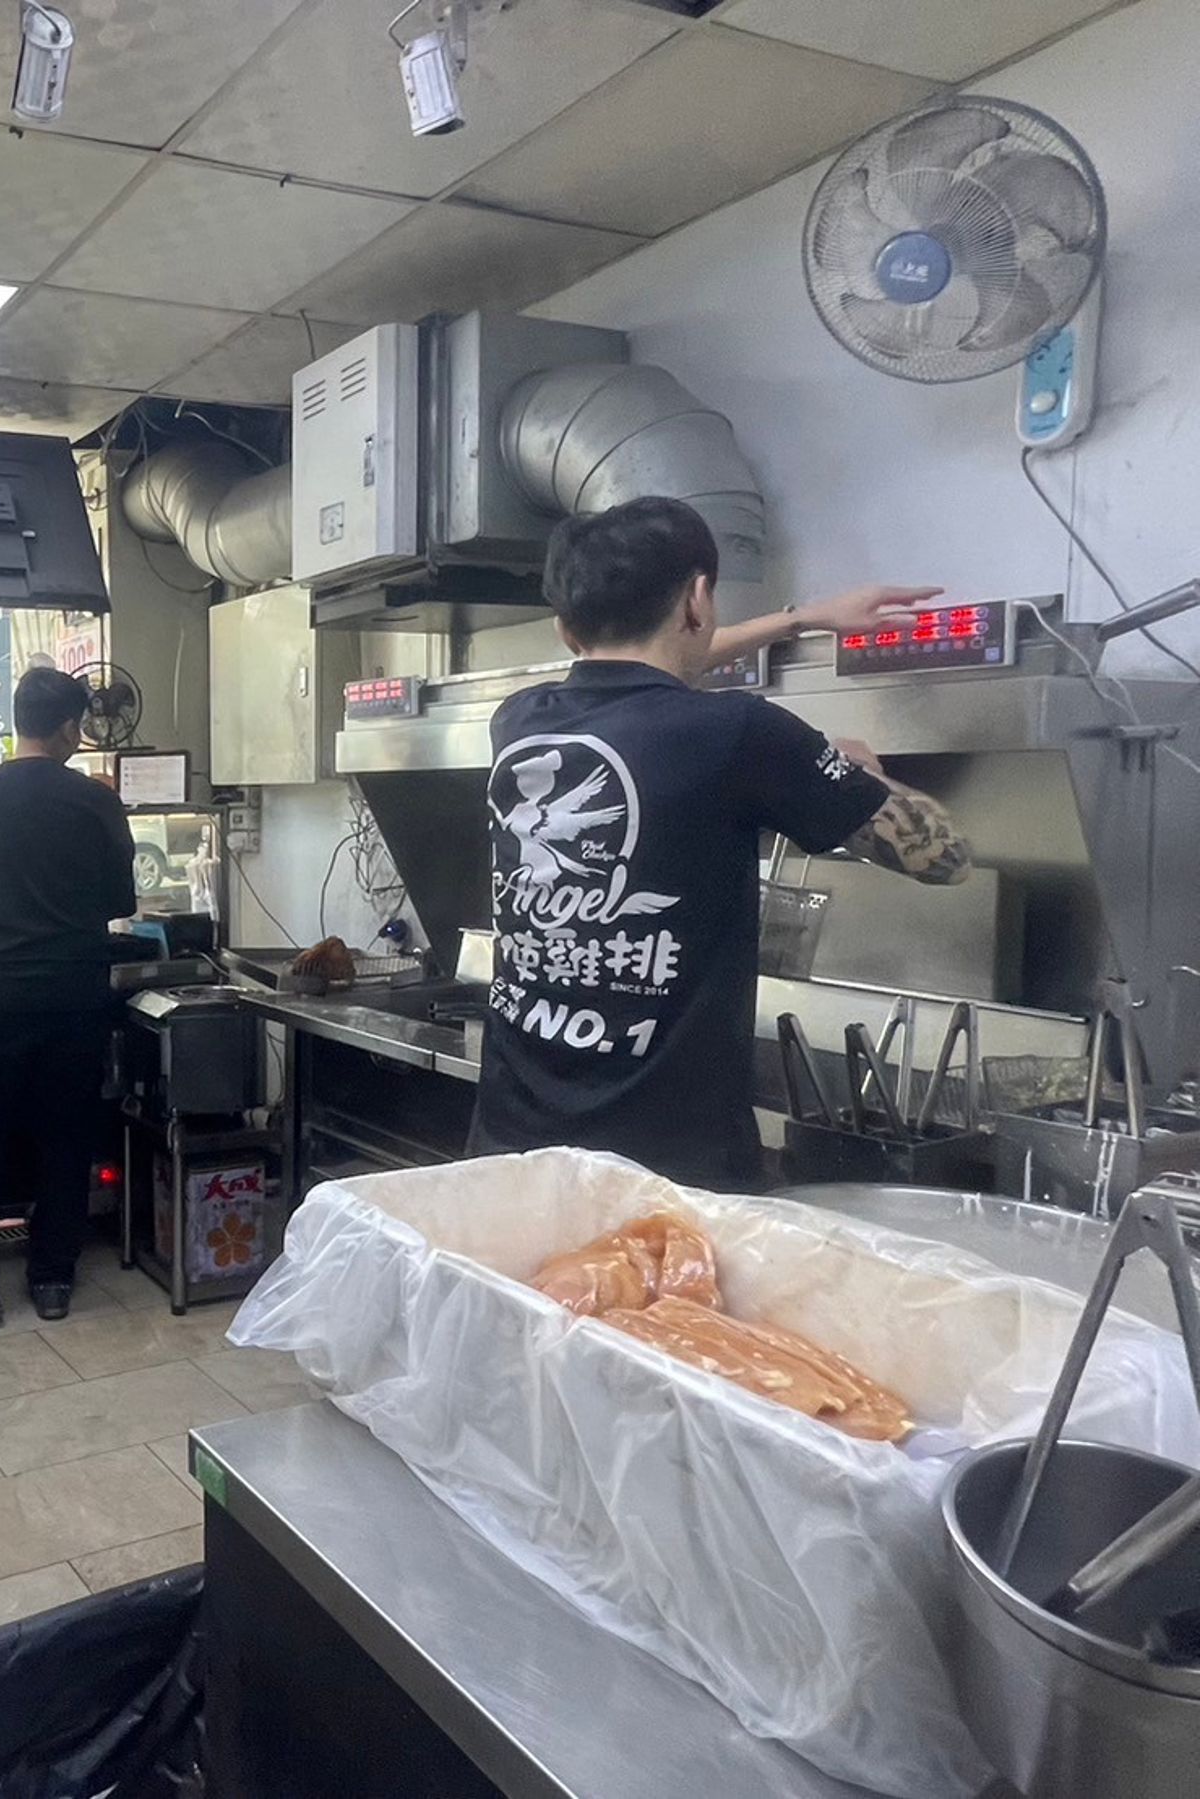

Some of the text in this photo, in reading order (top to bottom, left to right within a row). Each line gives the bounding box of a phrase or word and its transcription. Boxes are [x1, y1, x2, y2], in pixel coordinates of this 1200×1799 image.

[493, 864, 628, 930] Angel
[610, 981, 670, 996] SINCE 2014
